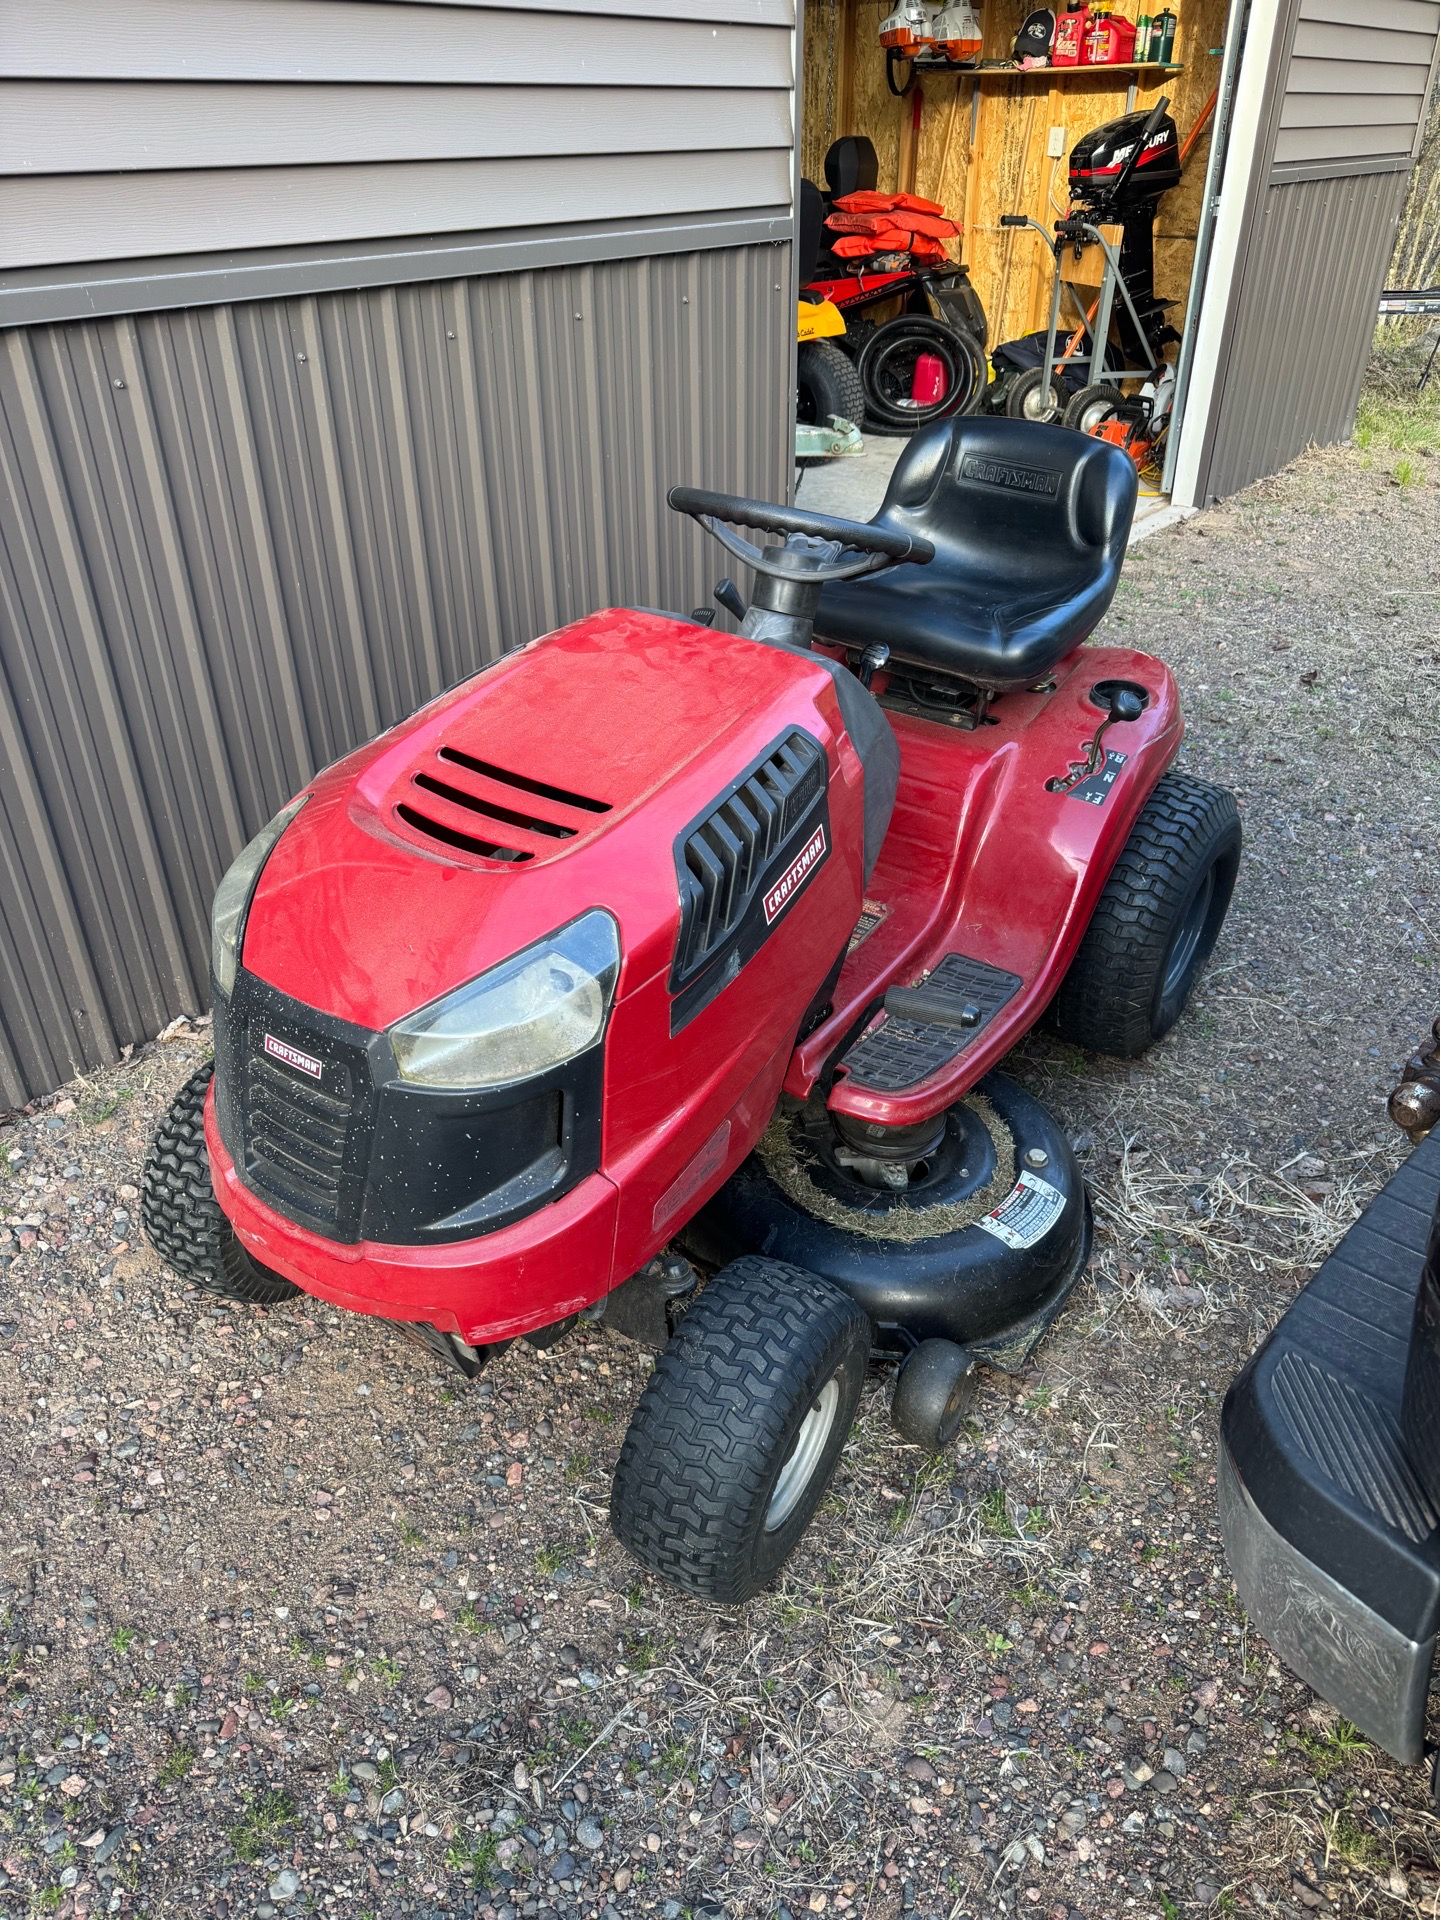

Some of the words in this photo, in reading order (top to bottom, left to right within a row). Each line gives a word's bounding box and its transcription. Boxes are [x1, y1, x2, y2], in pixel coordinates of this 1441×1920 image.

[1107, 129, 1170, 168] MEURY
[965, 459, 1057, 494] CRAFTSMAN
[1103, 773, 1115, 783] N
[767, 834, 822, 913] CRAFTSMAN
[268, 1039, 317, 1073] CRAFTSMAN
